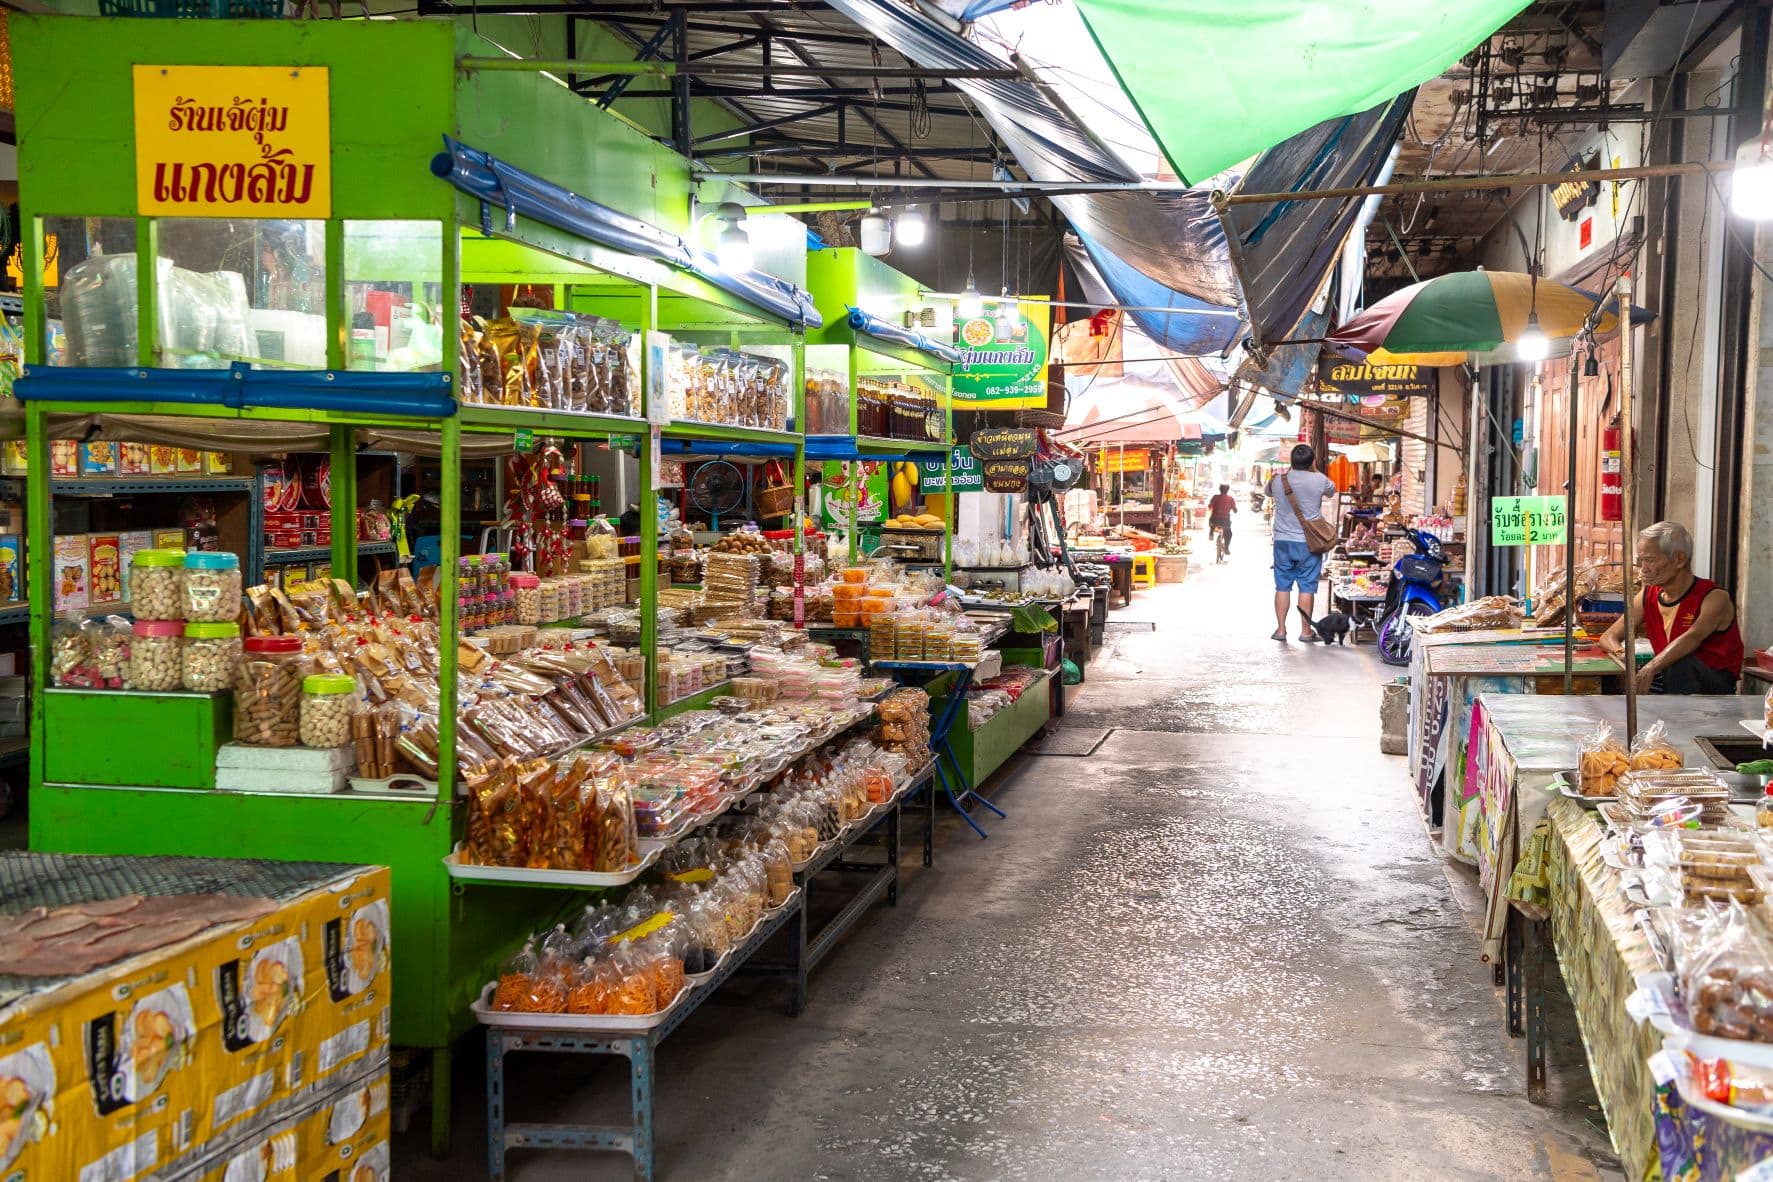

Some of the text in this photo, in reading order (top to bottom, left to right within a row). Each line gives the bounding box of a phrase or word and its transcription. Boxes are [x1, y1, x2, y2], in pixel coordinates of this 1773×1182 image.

[168, 96, 288, 145] ร้านเจ้ตุ่ม
[153, 144, 315, 204] แกงส้ม
[960, 345, 1034, 371] ตุ่มแกงส้ม
[923, 472, 981, 487] มะพราวอ่อน
[1530, 530, 1538, 542] 2
